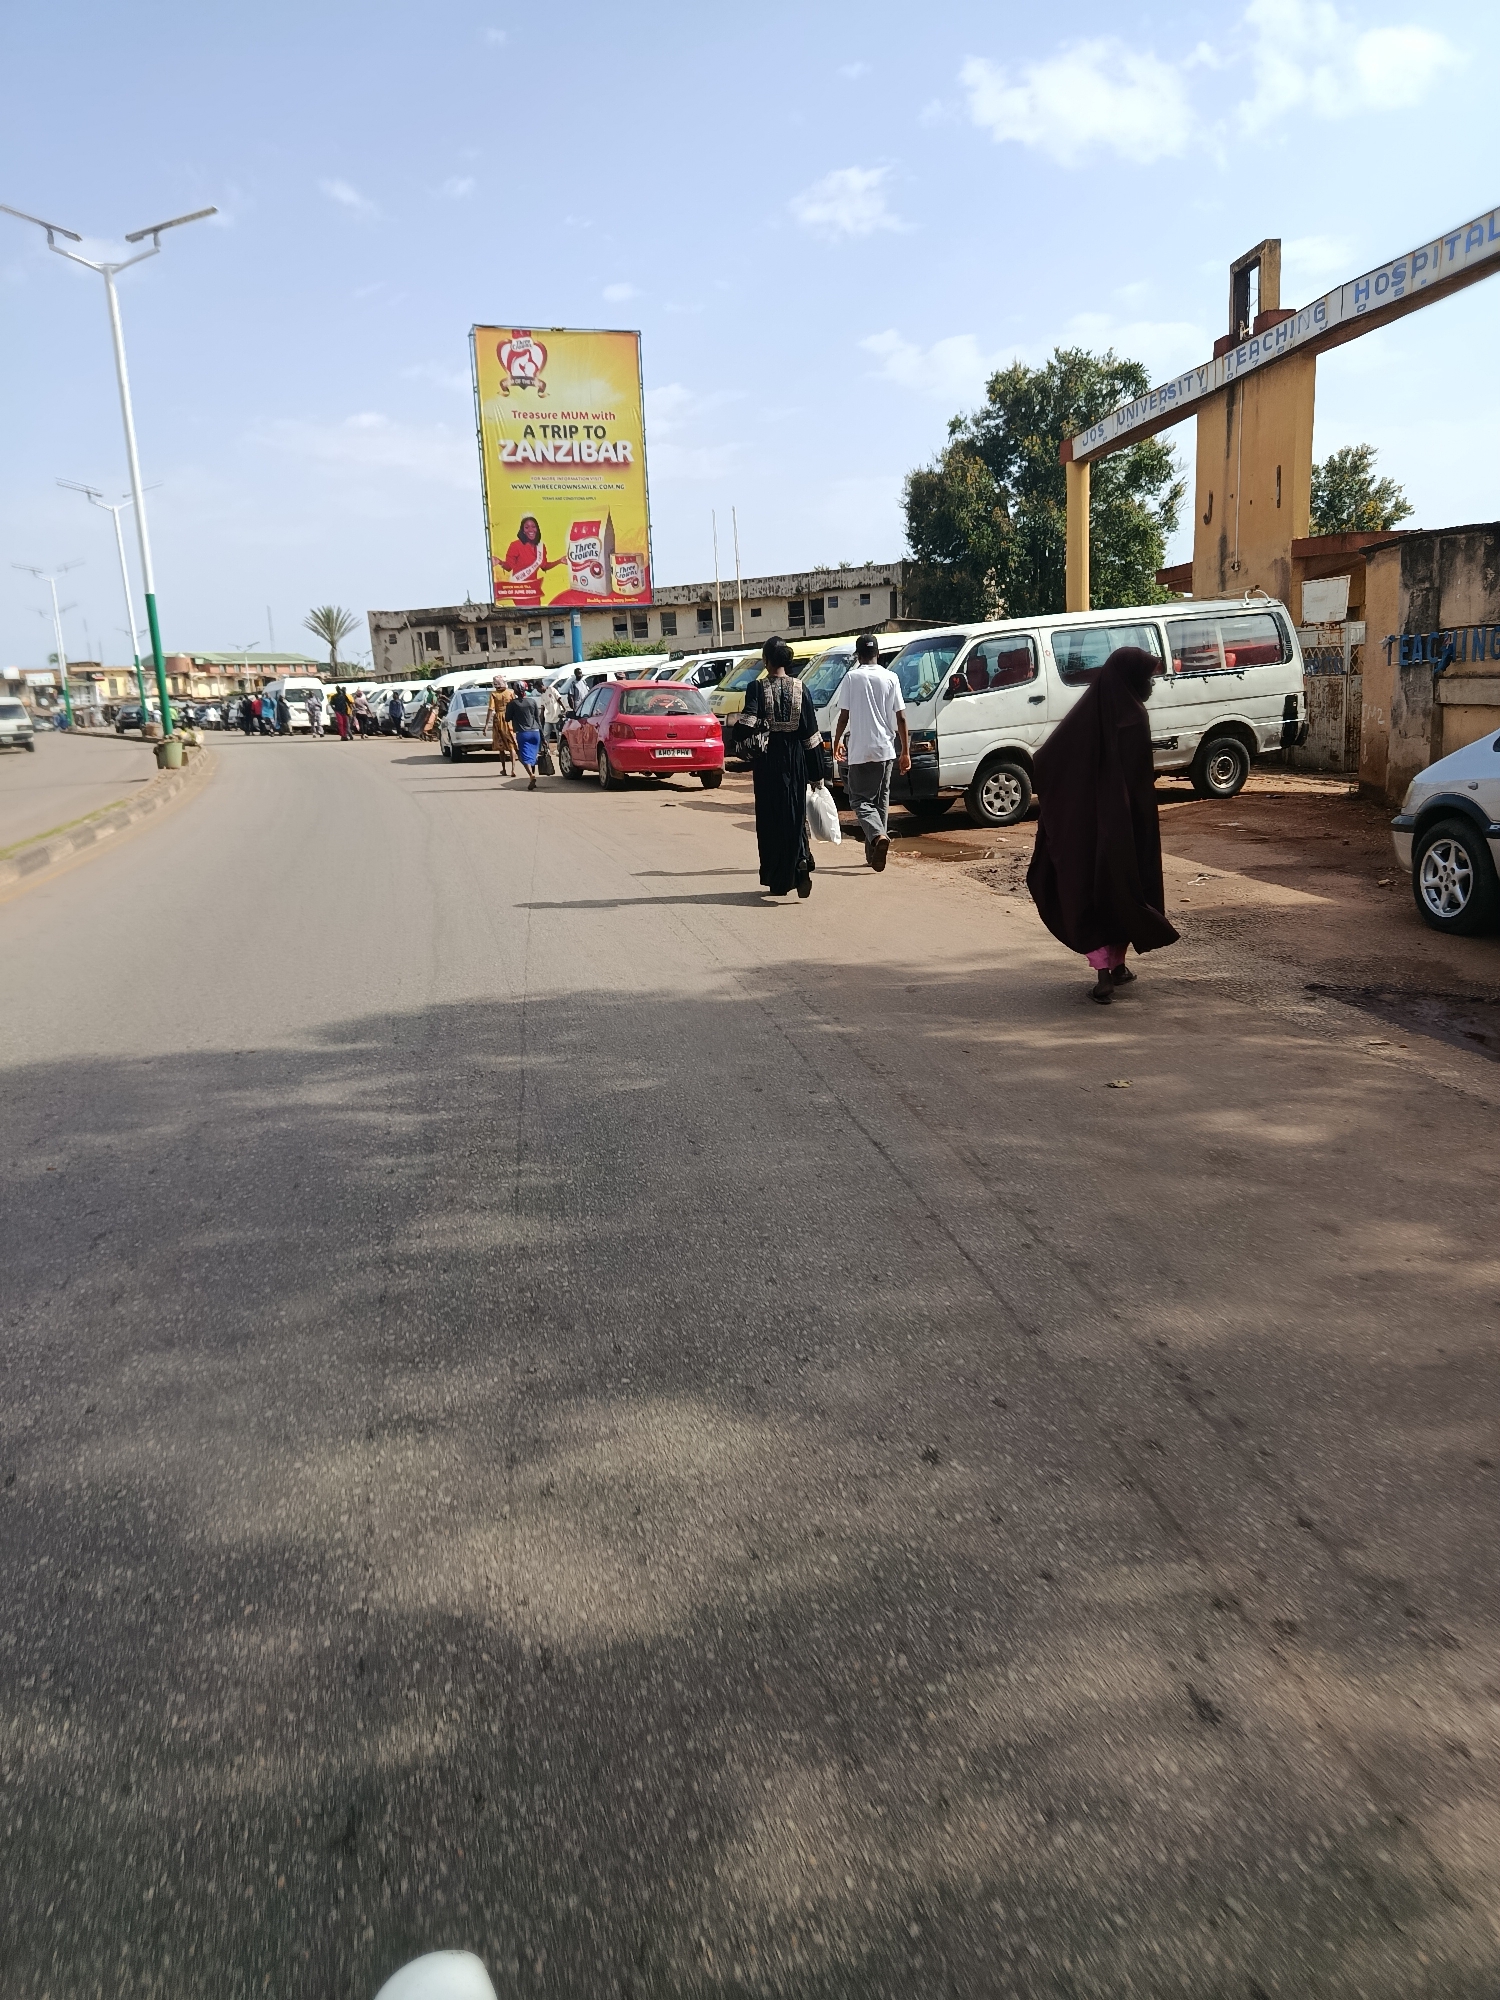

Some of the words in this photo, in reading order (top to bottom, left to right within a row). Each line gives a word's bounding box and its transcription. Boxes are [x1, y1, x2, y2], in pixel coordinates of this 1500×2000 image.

[1082, 423, 1105, 446] JOS
[1116, 368, 1205, 426] UNIVERSITY
[1225, 301, 1326, 371] TEACHING
[1354, 217, 1500, 304] HOSPITAL
[512, 410, 558, 420] Treasure
[561, 411, 588, 420] MUM
[592, 411, 615, 420] with
[524, 425, 535, 438] A
[539, 425, 579, 439] TRIP
[583, 425, 606, 439] TO
[498, 439, 634, 463] ZANZIBAR
[575, 542, 596, 553] Three
[570, 549, 598, 560] Crowns
[619, 565, 635, 573] Three
